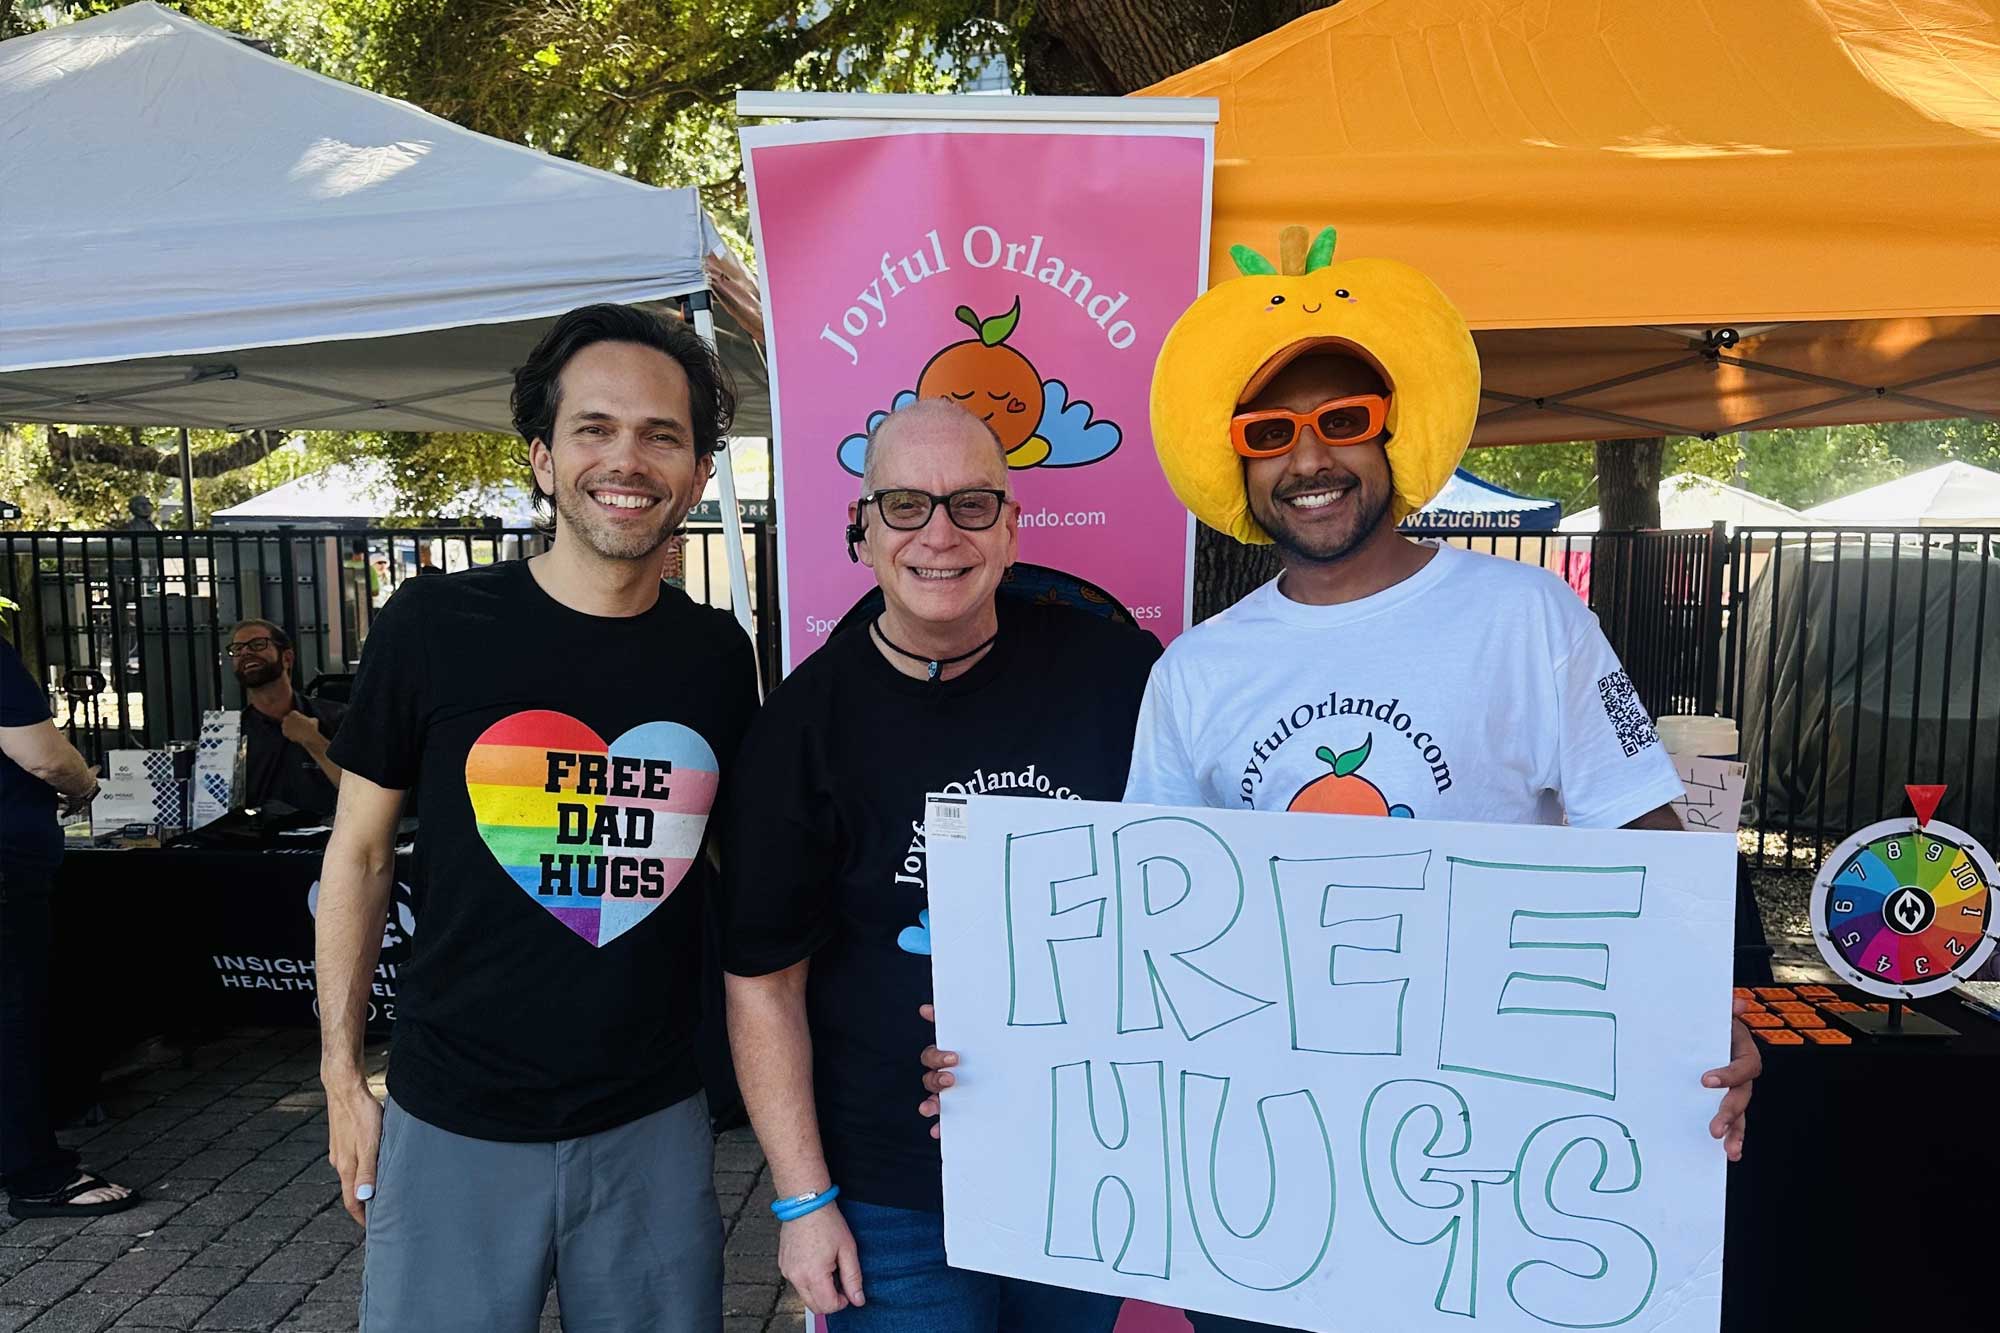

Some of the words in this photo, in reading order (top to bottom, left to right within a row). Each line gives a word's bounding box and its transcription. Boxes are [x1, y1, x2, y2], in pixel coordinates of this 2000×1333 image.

[819, 229, 951, 366] Joyful
[962, 224, 1137, 350] Orlando
[1016, 507, 1106, 529] ando.com
[1239, 690, 1456, 812] JoyfulOrlando.com
[545, 751, 672, 801] FREE
[556, 802, 655, 849] DAD
[1887, 841, 1902, 860] 8
[1925, 843, 1944, 862] 9
[538, 853, 665, 900] HUGS
[1849, 861, 1867, 880] 7
[1951, 861, 1979, 890] 10
[1834, 899, 1854, 913] 6
[1961, 906, 1983, 918] 1
[1841, 931, 1862, 948] 5
[1945, 938, 1965, 956] 2
[212, 955, 317, 974] INSIGH
[1006, 816, 1647, 1101] FREE
[1876, 955, 1892, 973] 4
[1914, 956, 1930, 975] 3
[220, 974, 315, 991] HEALTH
[1045, 1058, 1658, 1328] HUGS
